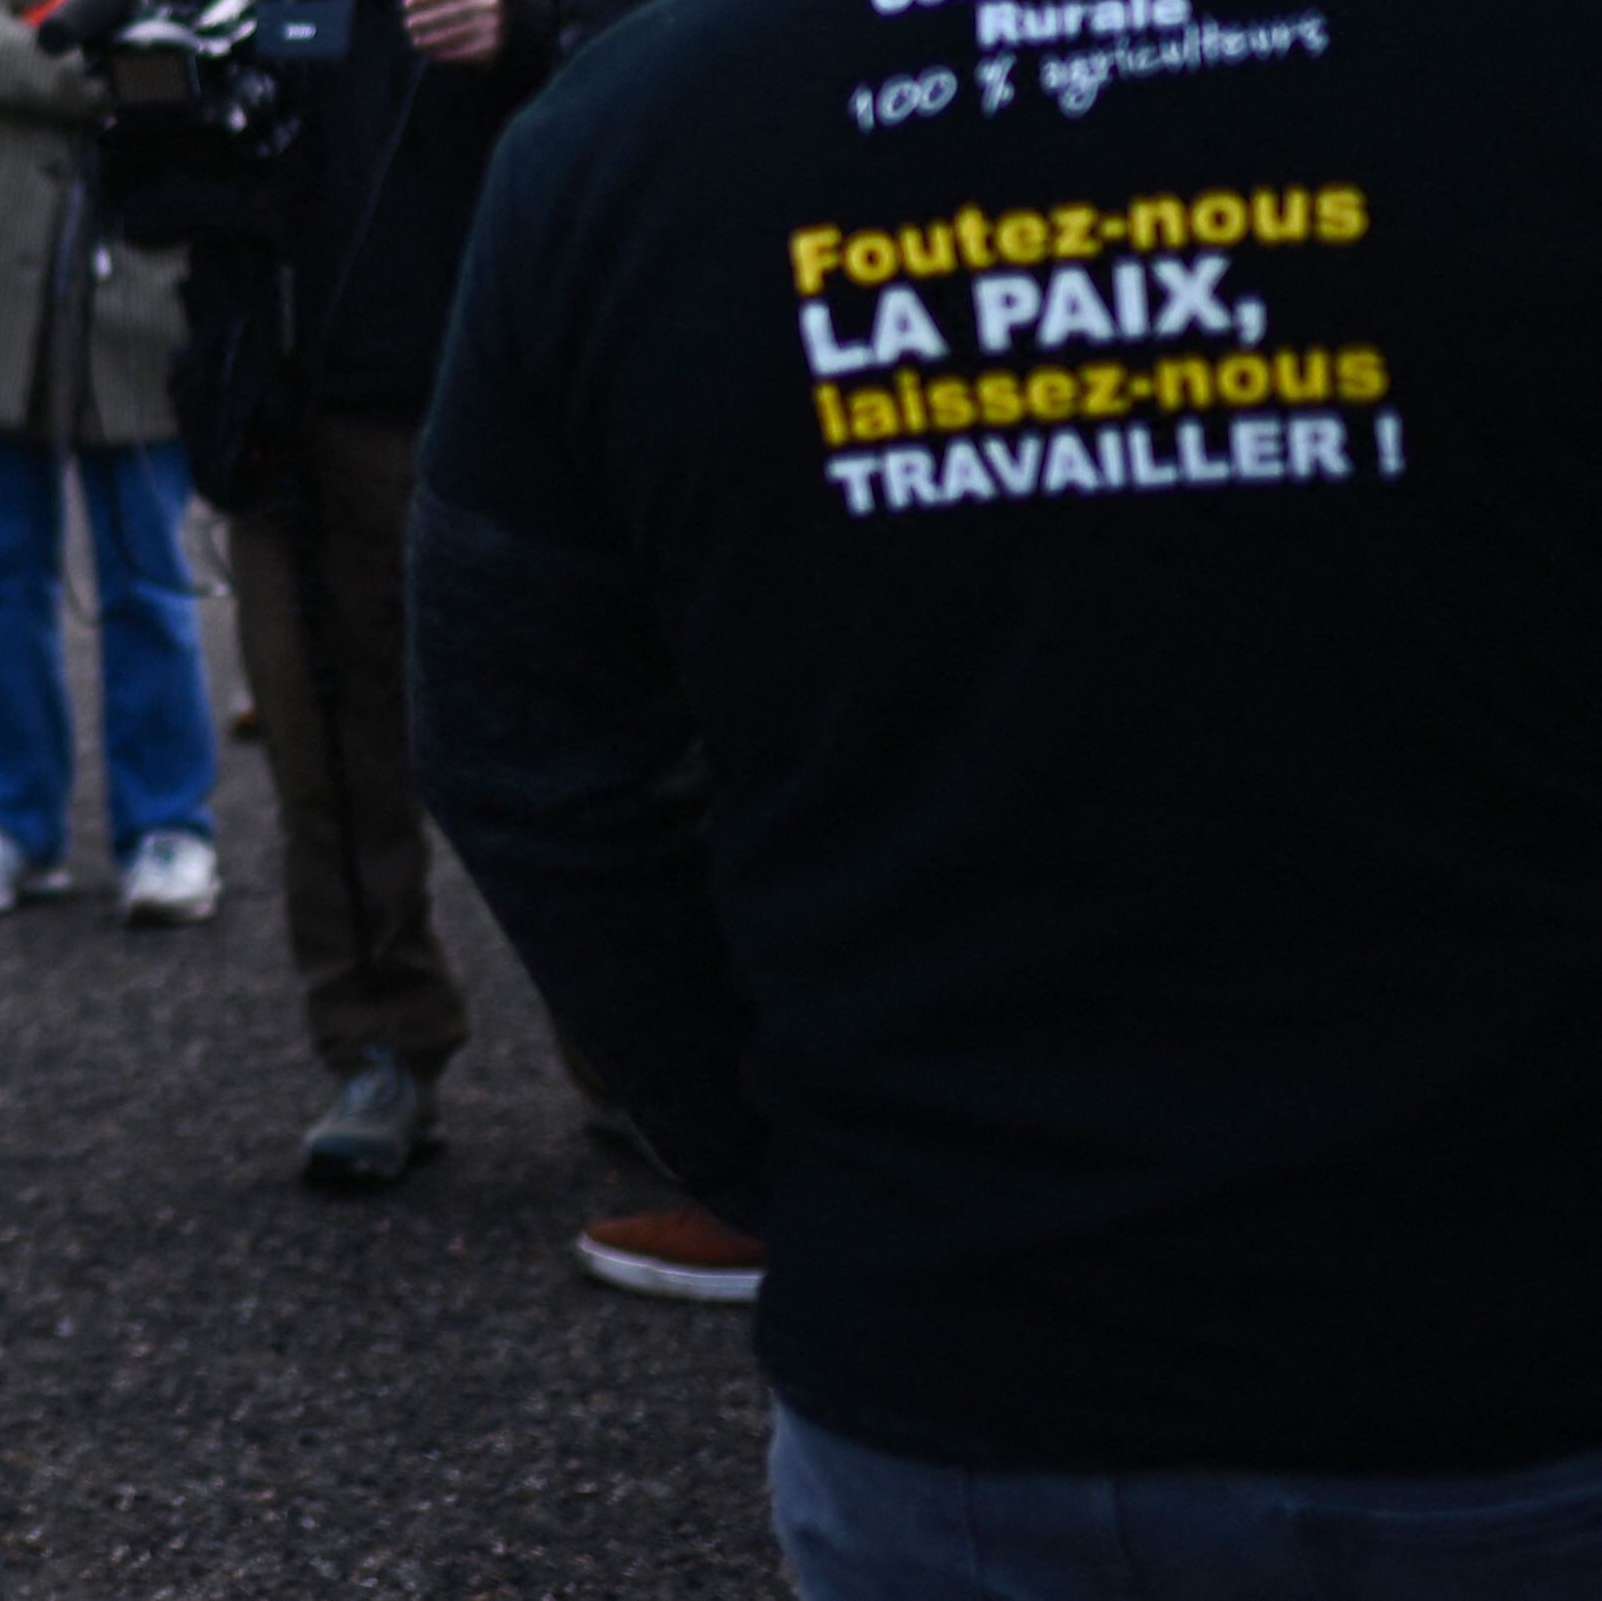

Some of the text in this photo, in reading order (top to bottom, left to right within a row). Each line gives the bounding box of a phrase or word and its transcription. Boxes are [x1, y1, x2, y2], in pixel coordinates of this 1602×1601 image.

[850, 10, 1329, 132] 100 % agriculteurs
[790, 184, 1369, 295] Foutez-nous
[800, 256, 1267, 376] LA PAIX,
[815, 347, 1389, 446] laissez-nous
[827, 409, 1403, 515] TRAVAILLER !
